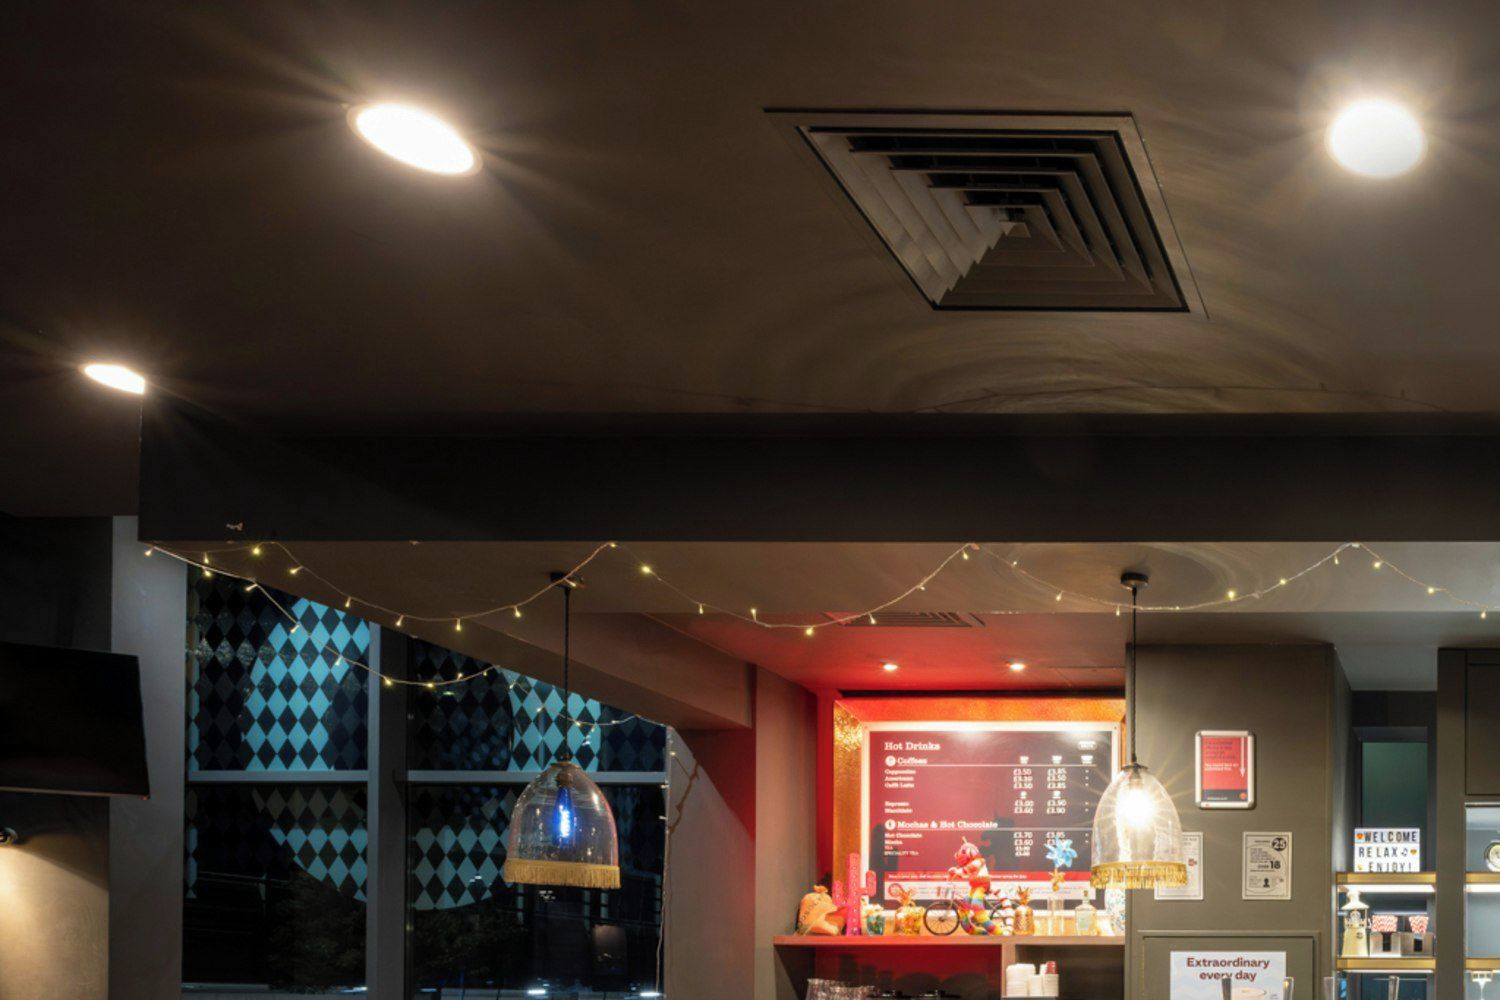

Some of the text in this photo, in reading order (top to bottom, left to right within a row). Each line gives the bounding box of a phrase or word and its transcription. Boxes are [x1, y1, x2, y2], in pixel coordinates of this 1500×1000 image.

[884, 741, 941, 751] Hot Drinks
[897, 820, 998, 829] Mochas & Hot Chocolate
[1364, 831, 1417, 842] WELCOME
[1358, 847, 1398, 857] RELAX
[1270, 860, 1281, 869] 18
[1186, 957, 1271, 969] Extraordinary
[1199, 970, 1257, 982] every day
